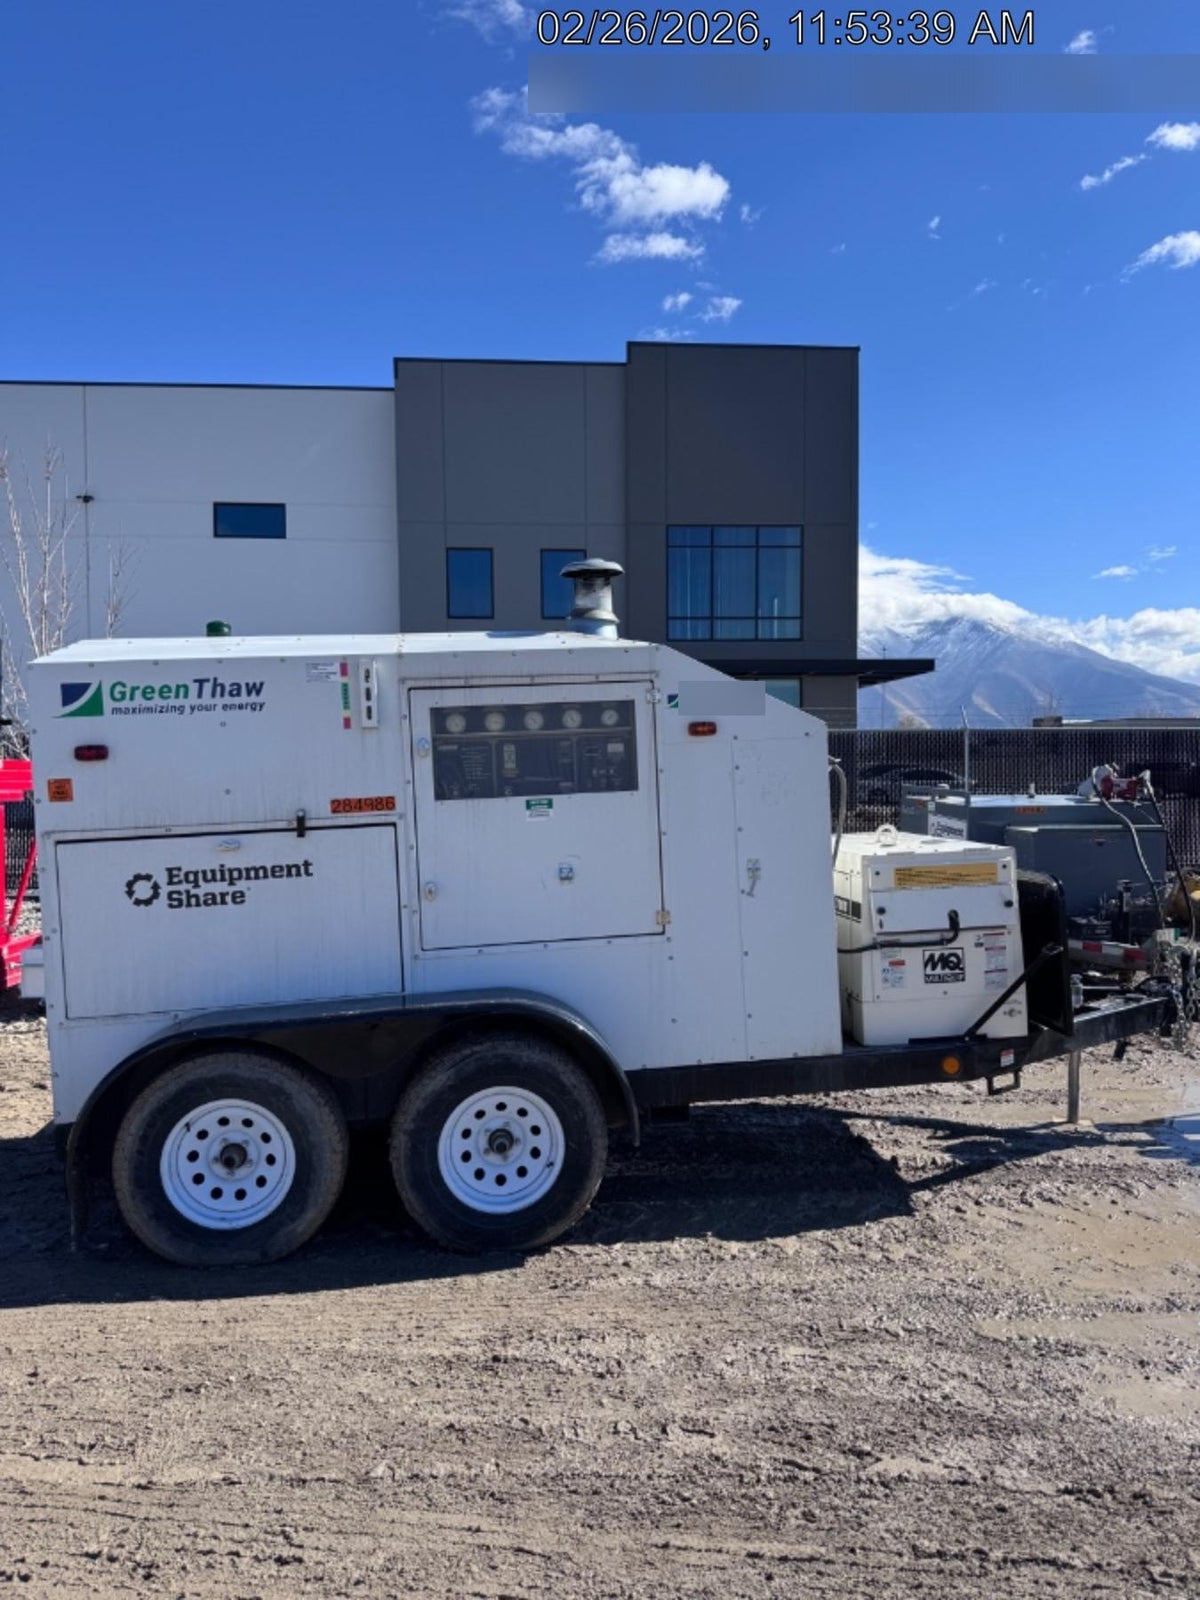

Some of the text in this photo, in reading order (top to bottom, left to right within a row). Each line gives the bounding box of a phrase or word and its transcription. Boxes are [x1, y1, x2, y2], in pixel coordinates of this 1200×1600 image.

[111, 701, 266, 716] maximizing your energy
[330, 796, 396, 814] 284986
[165, 859, 314, 888] Equipment
[166, 889, 247, 909] Share
[924, 952, 965, 972] MQ
